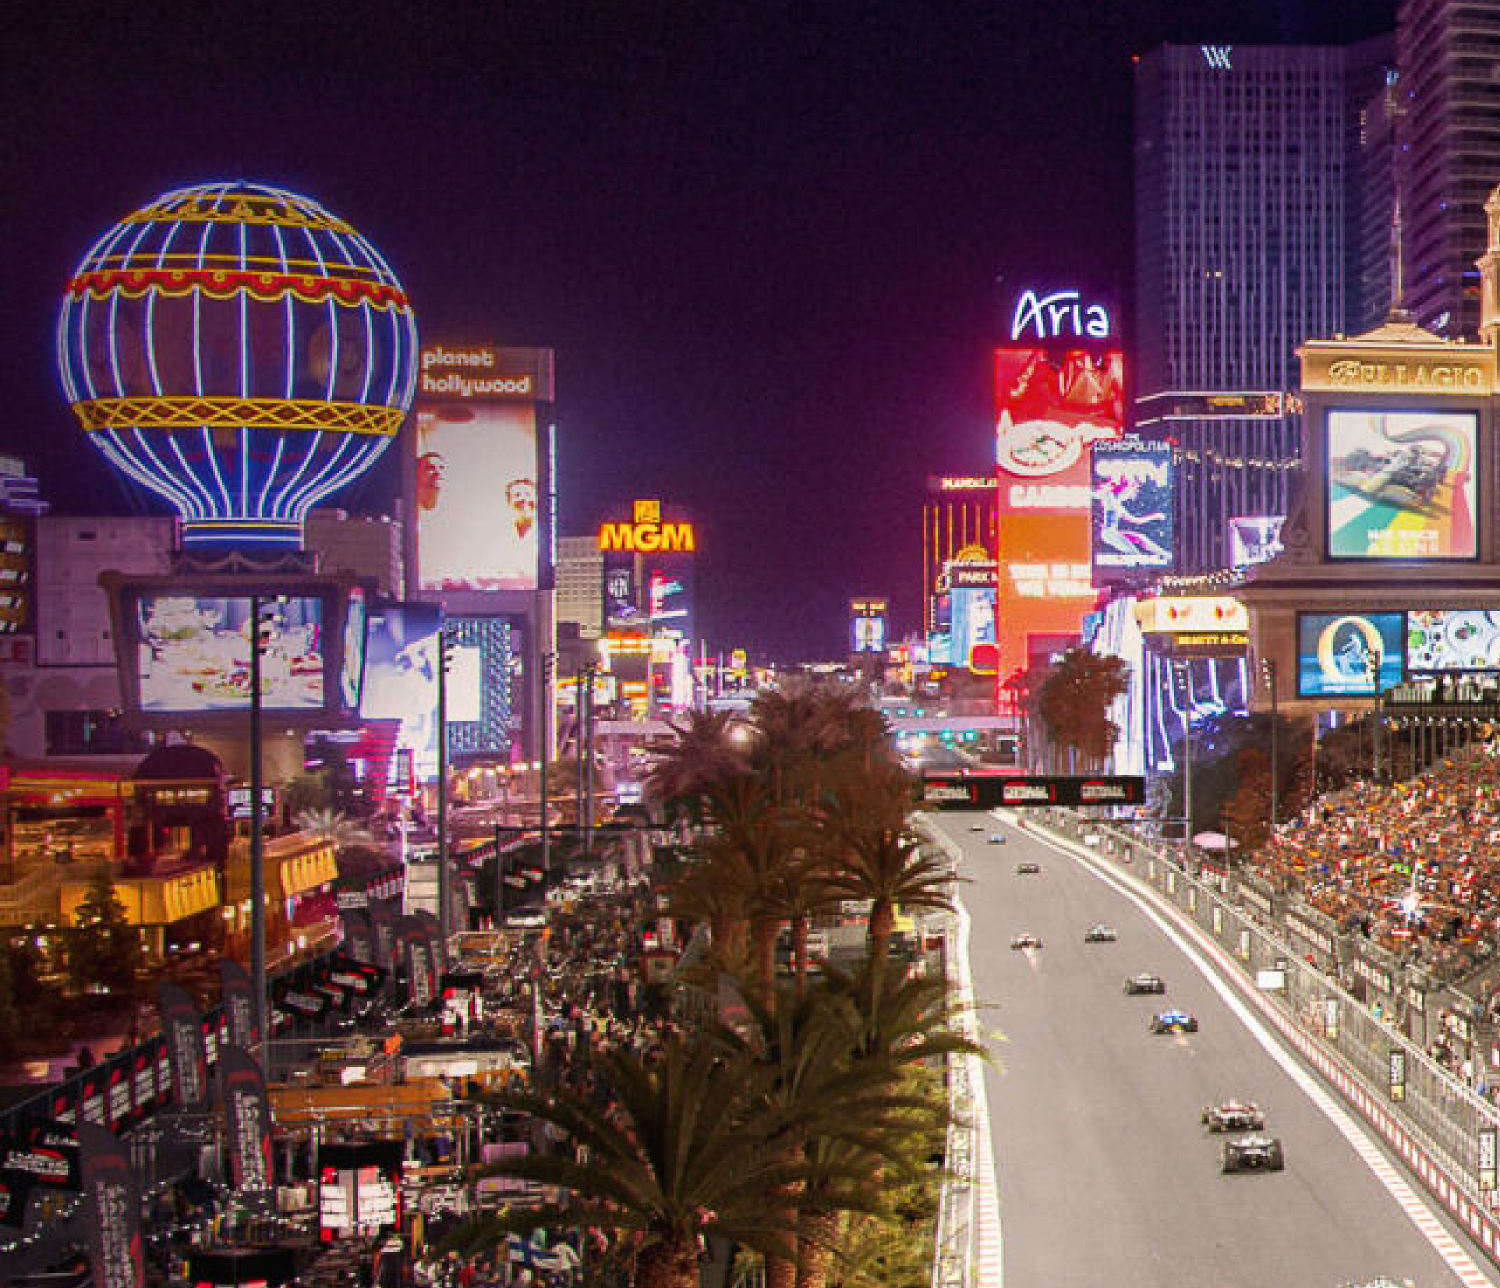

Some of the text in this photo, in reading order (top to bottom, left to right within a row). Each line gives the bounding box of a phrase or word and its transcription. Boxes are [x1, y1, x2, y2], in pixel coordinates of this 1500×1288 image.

[1011, 289, 1110, 340] Aria
[422, 347, 494, 368] planet
[422, 374, 531, 396] hollywood
[1329, 360, 1482, 387] BELLAGIO
[600, 523, 695, 551] MGM
